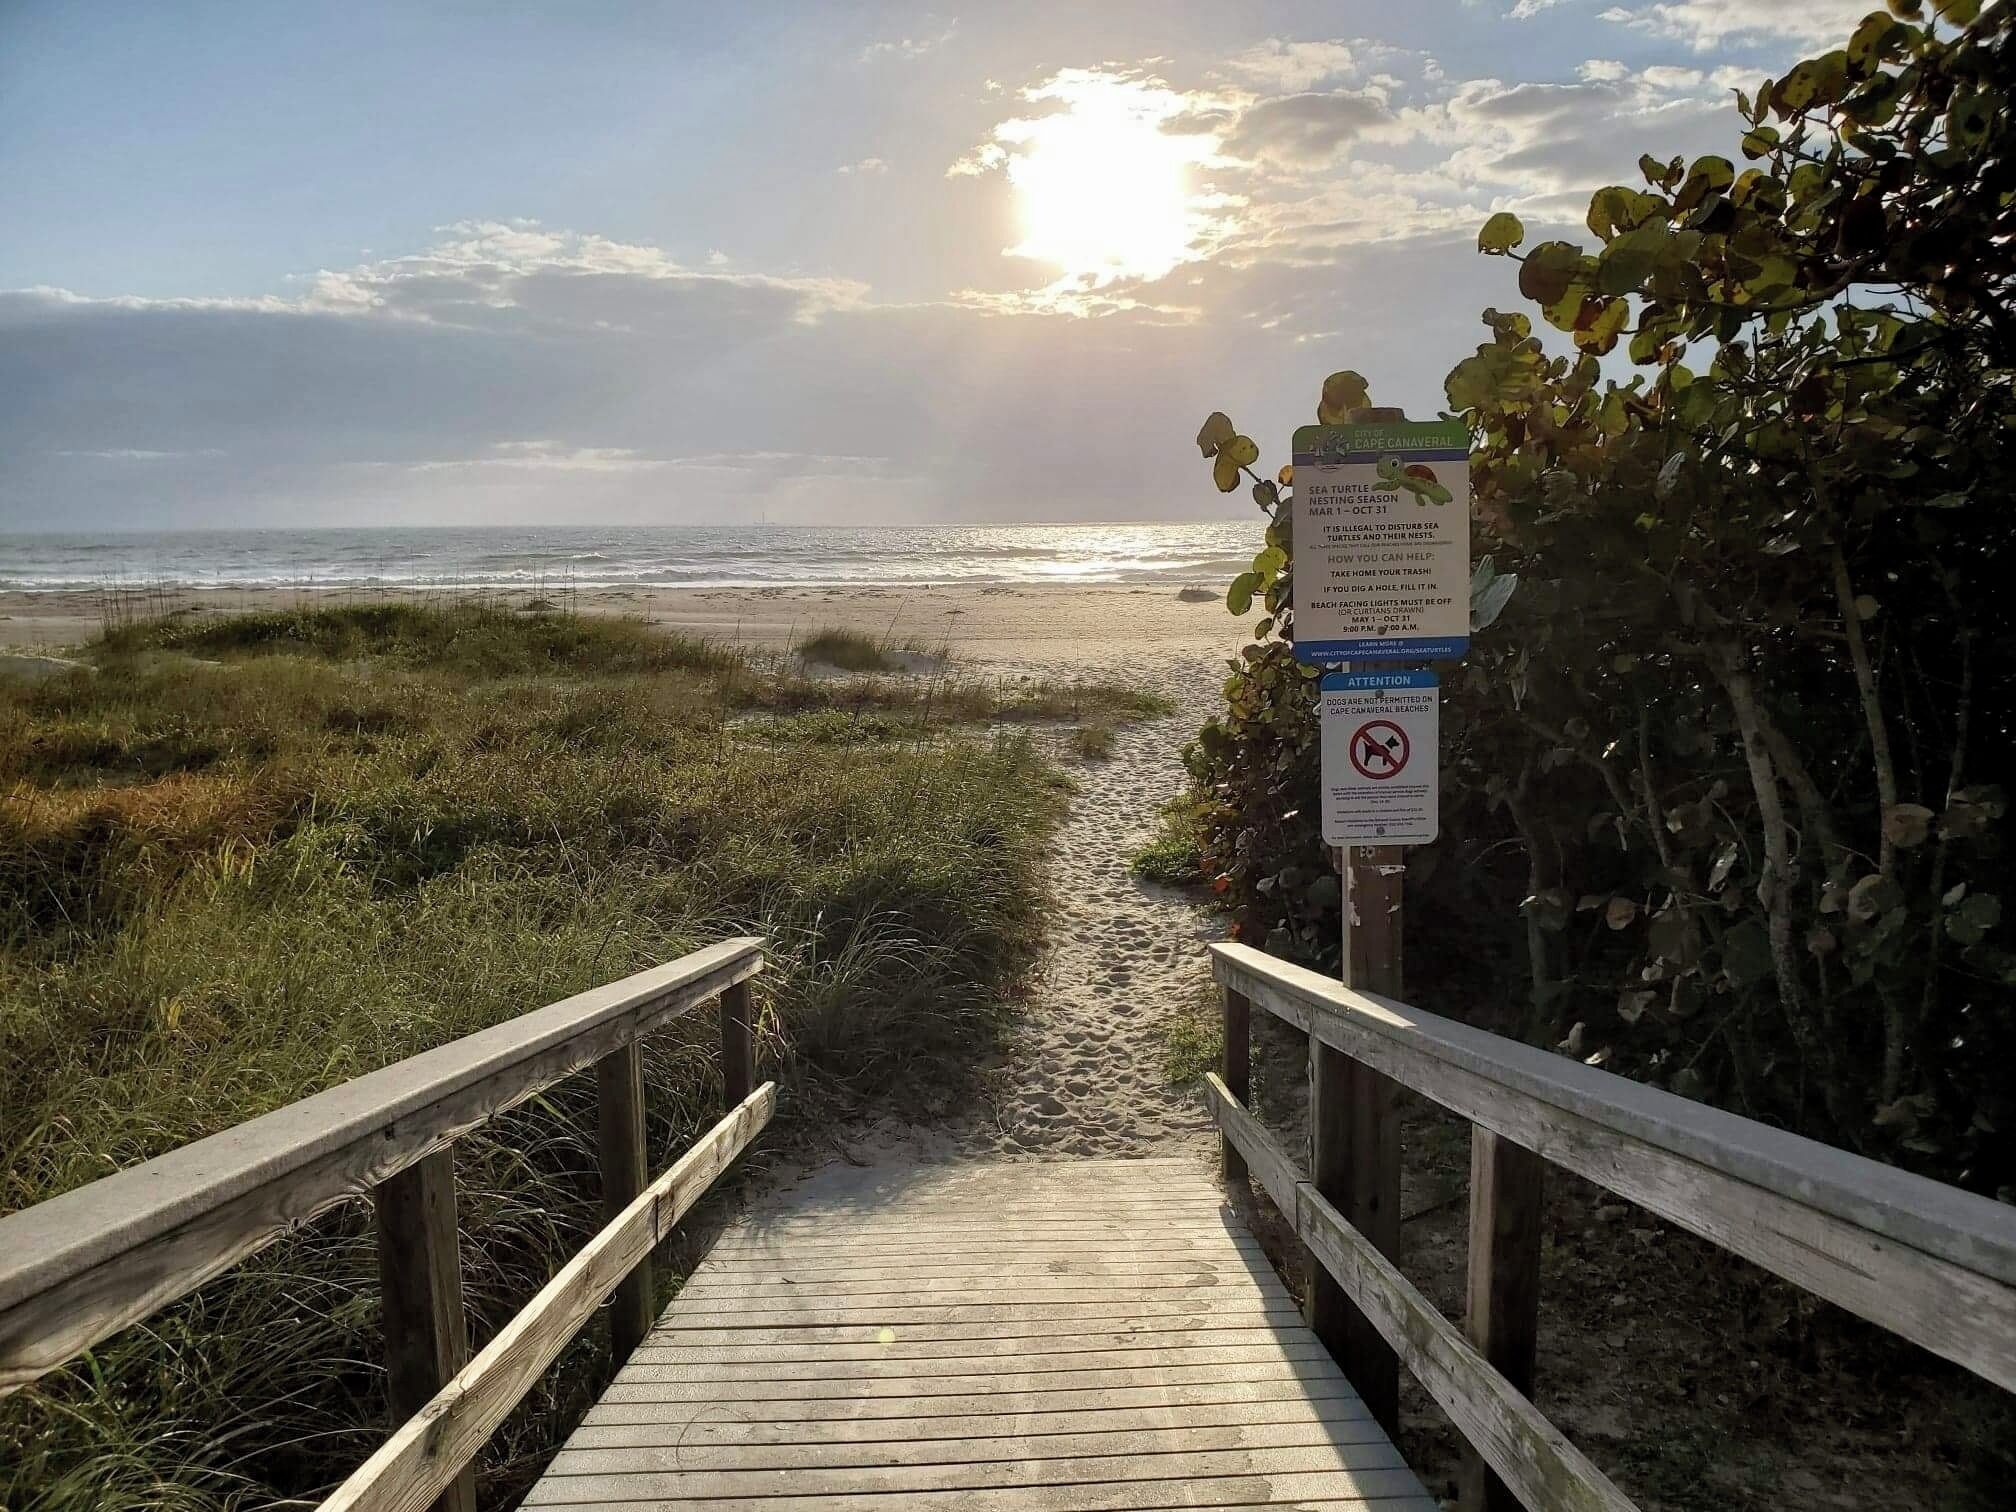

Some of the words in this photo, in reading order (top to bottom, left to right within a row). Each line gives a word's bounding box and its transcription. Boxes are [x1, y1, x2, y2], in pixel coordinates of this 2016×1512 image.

[1355, 439, 1385, 448] CAPE
[1388, 436, 1453, 448] CANAVERAL
[1309, 486, 1328, 494] SEA
[1332, 484, 1369, 493] TURTLE
[1309, 496, 1355, 505] NESTING
[1358, 494, 1398, 503] SEASON
[1309, 506, 1332, 516] MAR
[1336, 506, 1341, 514] 1
[1353, 506, 1372, 515] OCT
[1376, 506, 1387, 514] 31
[1388, 523, 1422, 531] DISTURB
[1328, 534, 1361, 542] TURTLES
[1363, 533, 1381, 541] AND
[1328, 555, 1354, 563] HOW
[1358, 554, 1378, 562] YOU
[1382, 553, 1403, 562] CAN
[1407, 552, 1435, 561] HELP:
[1402, 568, 1431, 576] TRASH!
[1311, 601, 1337, 609] BEACH
[1340, 600, 1368, 608] FACING
[1343, 625, 1358, 633] 9:00
[1348, 675, 1411, 687] ATTENTION
[1327, 697, 1347, 706] DOGS
[1348, 697, 1364, 705] ARE
[1365, 697, 1378, 705] NOT
[1380, 696, 1420, 704] PERMITTED
[1330, 706, 1350, 715] CAPE
[1351, 705, 1393, 714] CANAVERAL
[1396, 704, 1429, 713] BEACHES
